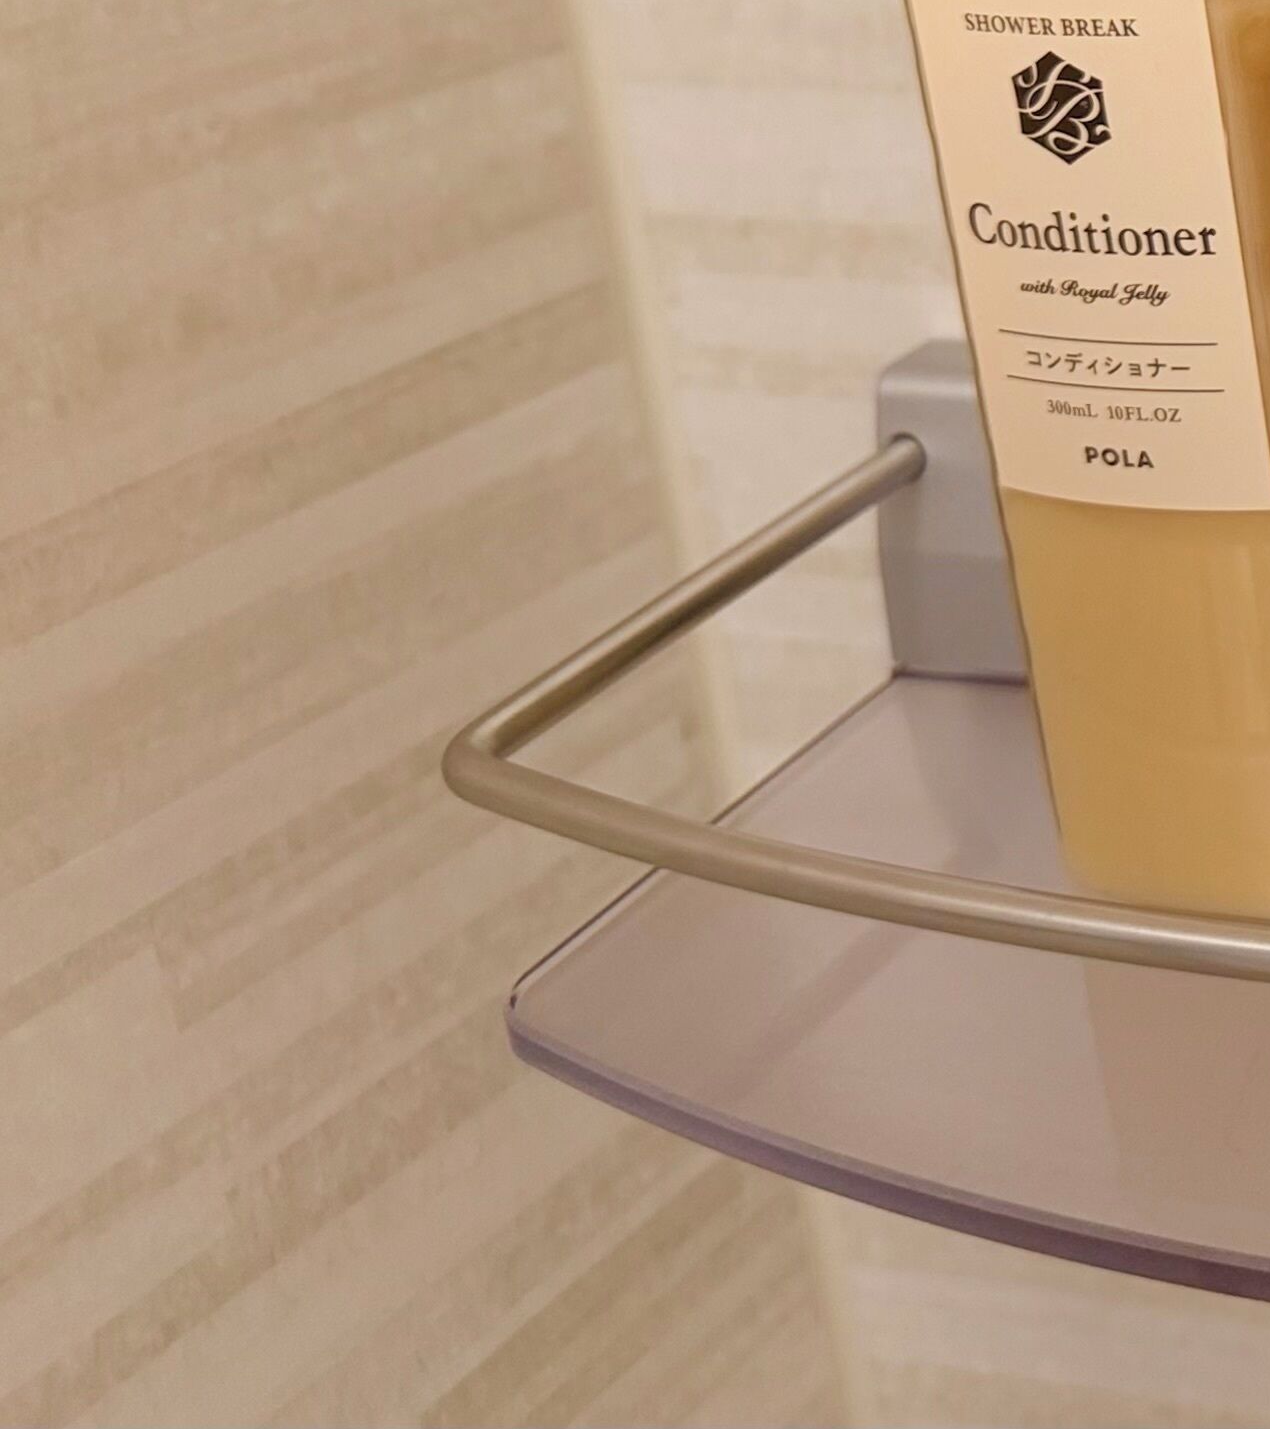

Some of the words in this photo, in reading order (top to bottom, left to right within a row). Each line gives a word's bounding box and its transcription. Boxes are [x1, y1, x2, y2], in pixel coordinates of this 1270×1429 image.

[964, 13, 1057, 36] SHOWER
[1060, 18, 1140, 37] BREAK
[968, 202, 1216, 256] Conditioner
[1020, 278, 1057, 295] with
[1059, 279, 1118, 304] Royal
[1118, 283, 1171, 307] Jelly
[1026, 351, 1191, 377] コンディショナー
[1048, 400, 1099, 418] 300mL
[1107, 405, 1182, 423] 10FL.OZ
[1084, 446, 1154, 468] POLA
